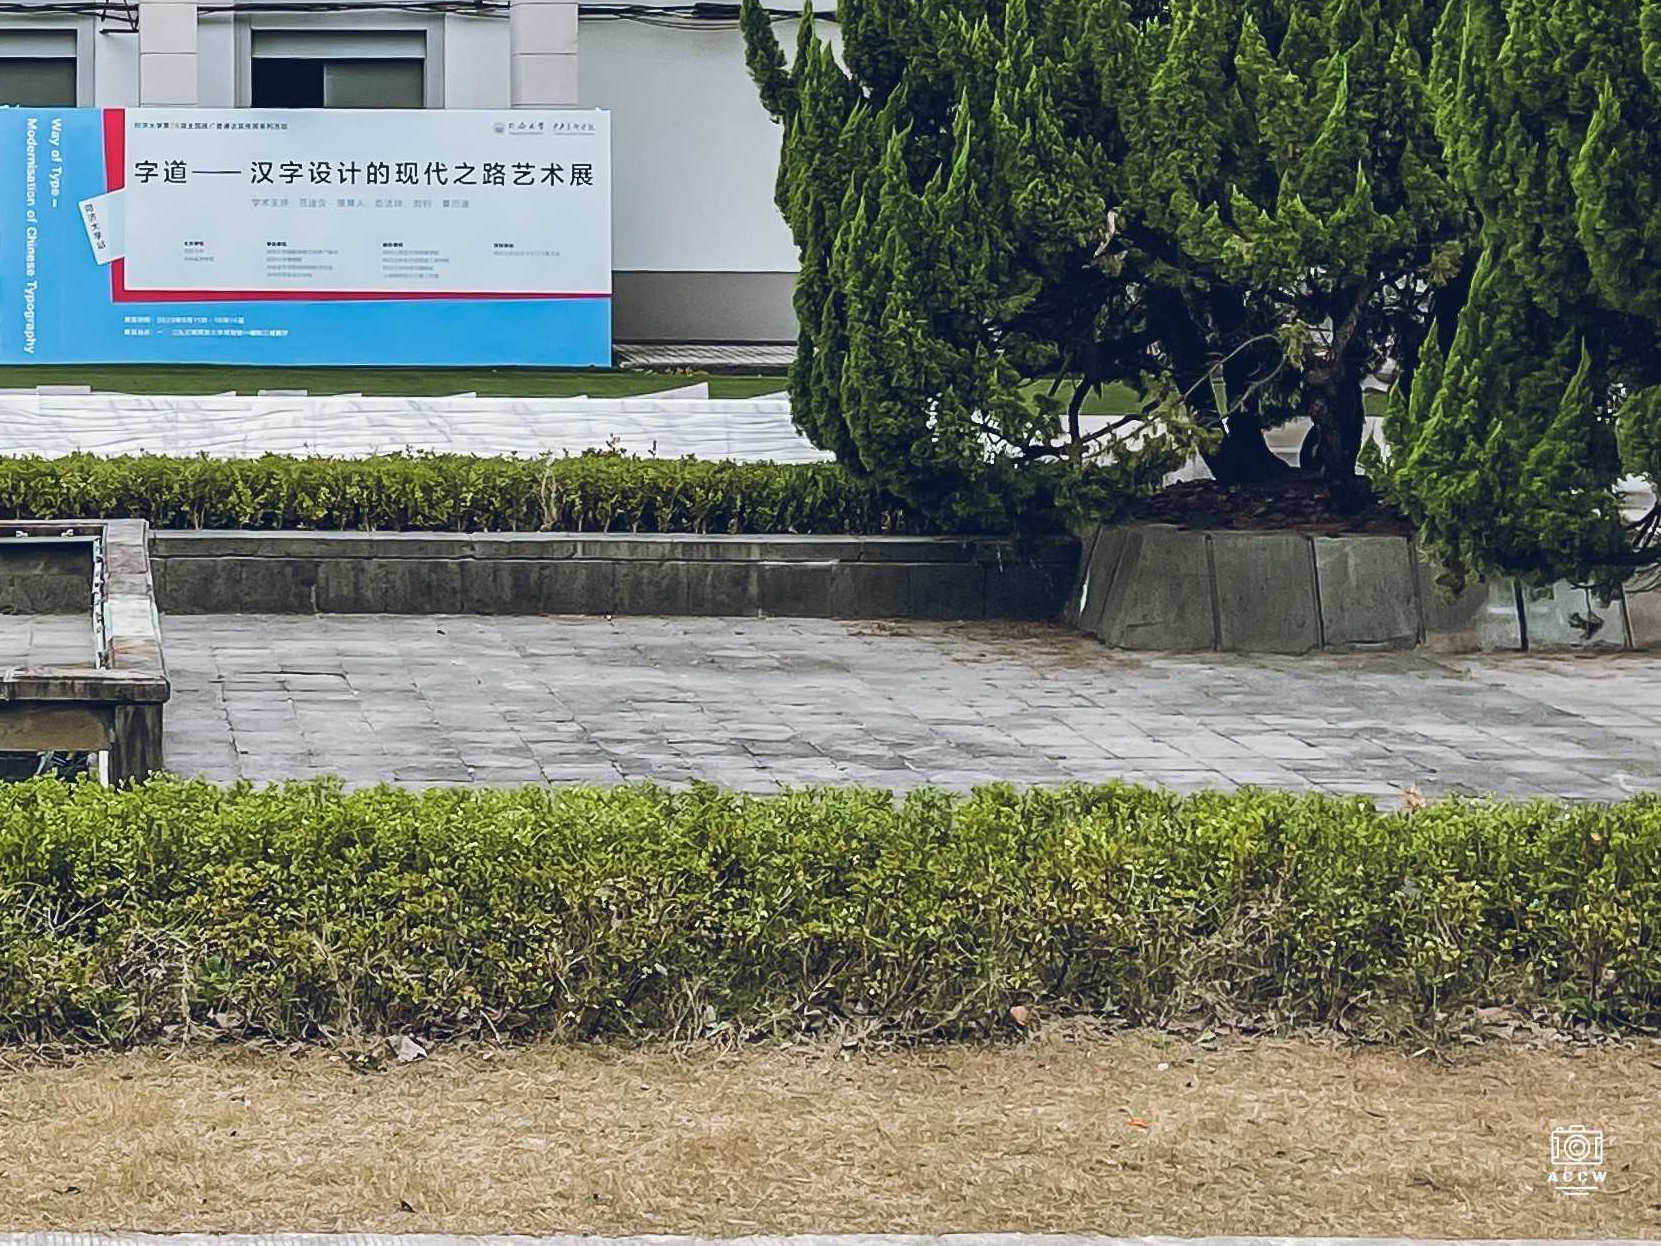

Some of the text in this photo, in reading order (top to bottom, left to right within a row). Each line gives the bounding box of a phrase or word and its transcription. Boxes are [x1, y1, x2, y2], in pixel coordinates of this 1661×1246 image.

[49, 118, 62, 146] Way
[51, 149, 62, 163] of
[49, 166, 62, 196] Type
[23, 118, 38, 354] Modernisation of Chinese Typography
